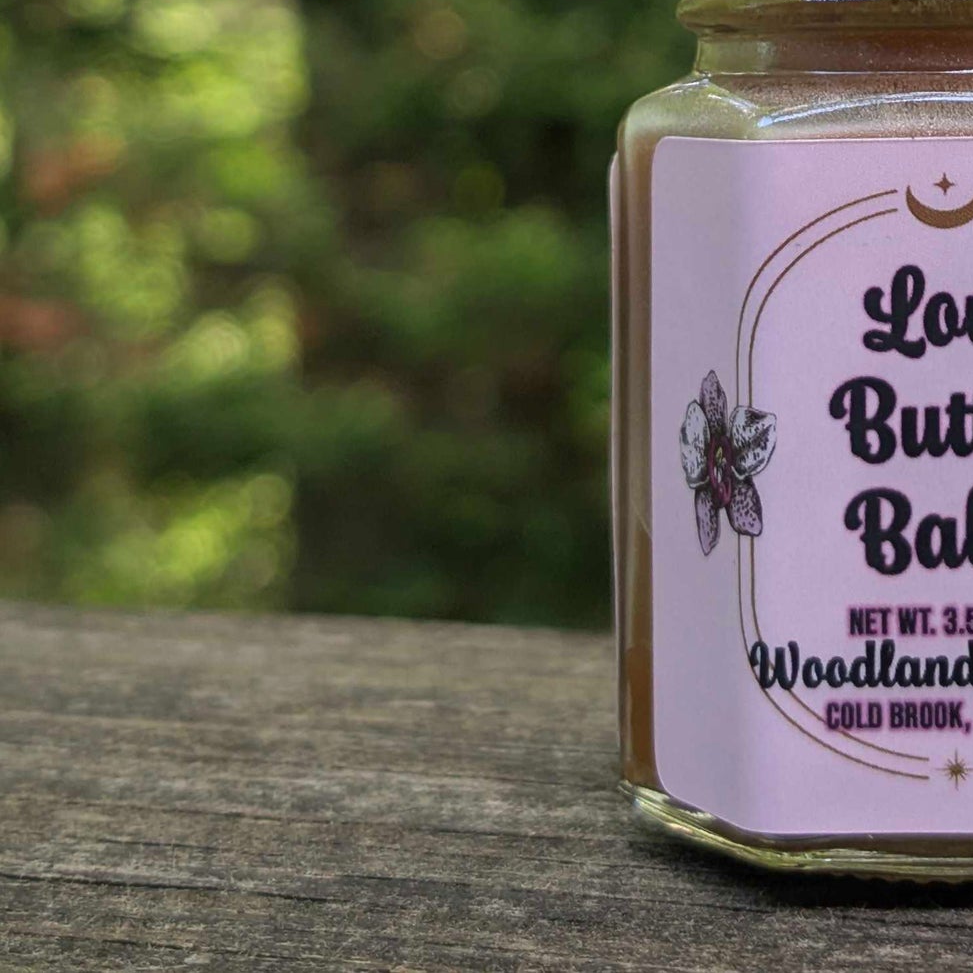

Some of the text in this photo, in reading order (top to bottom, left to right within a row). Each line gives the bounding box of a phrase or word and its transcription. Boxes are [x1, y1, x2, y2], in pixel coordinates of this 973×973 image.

[848, 607, 889, 636] NET
[897, 606, 937, 636] WT.
[825, 701, 883, 730] COLD
[889, 700, 971, 734] BROOK,
